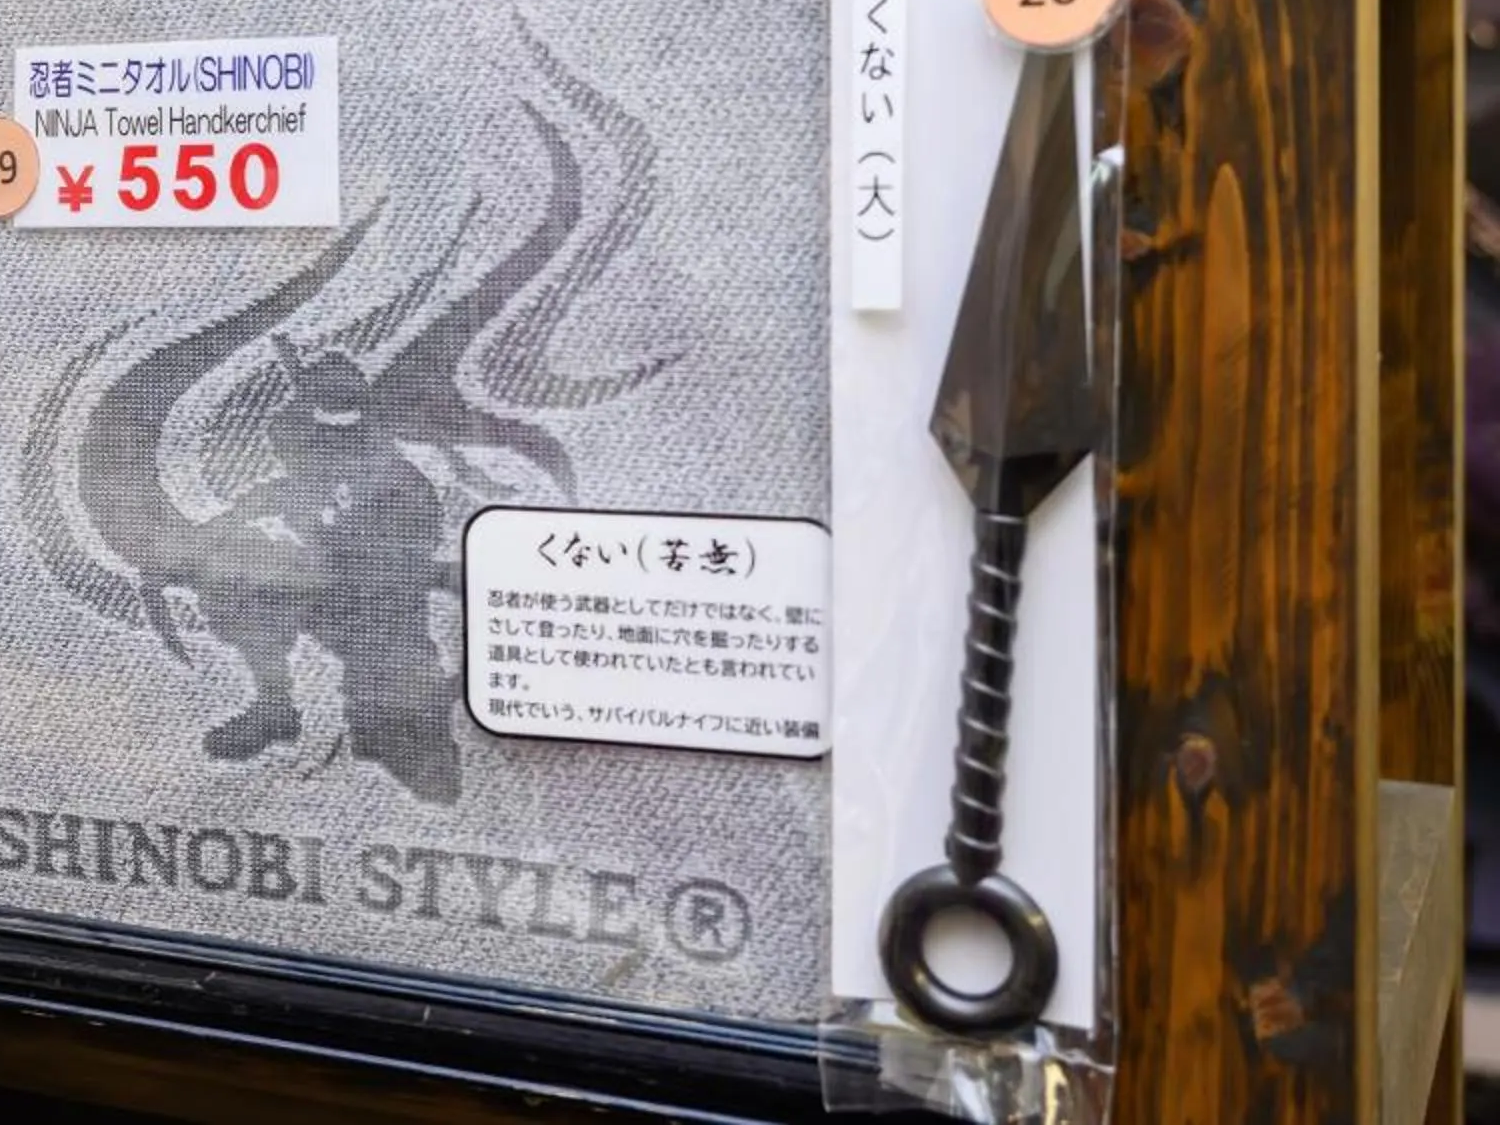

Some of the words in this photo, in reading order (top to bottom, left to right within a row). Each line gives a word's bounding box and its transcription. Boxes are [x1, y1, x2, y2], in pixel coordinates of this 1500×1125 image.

[35, 106, 98, 138] NINJA
[105, 105, 164, 135] Towel
[170, 103, 307, 135] Handkerchief
[356, 842, 641, 948] STYLE
